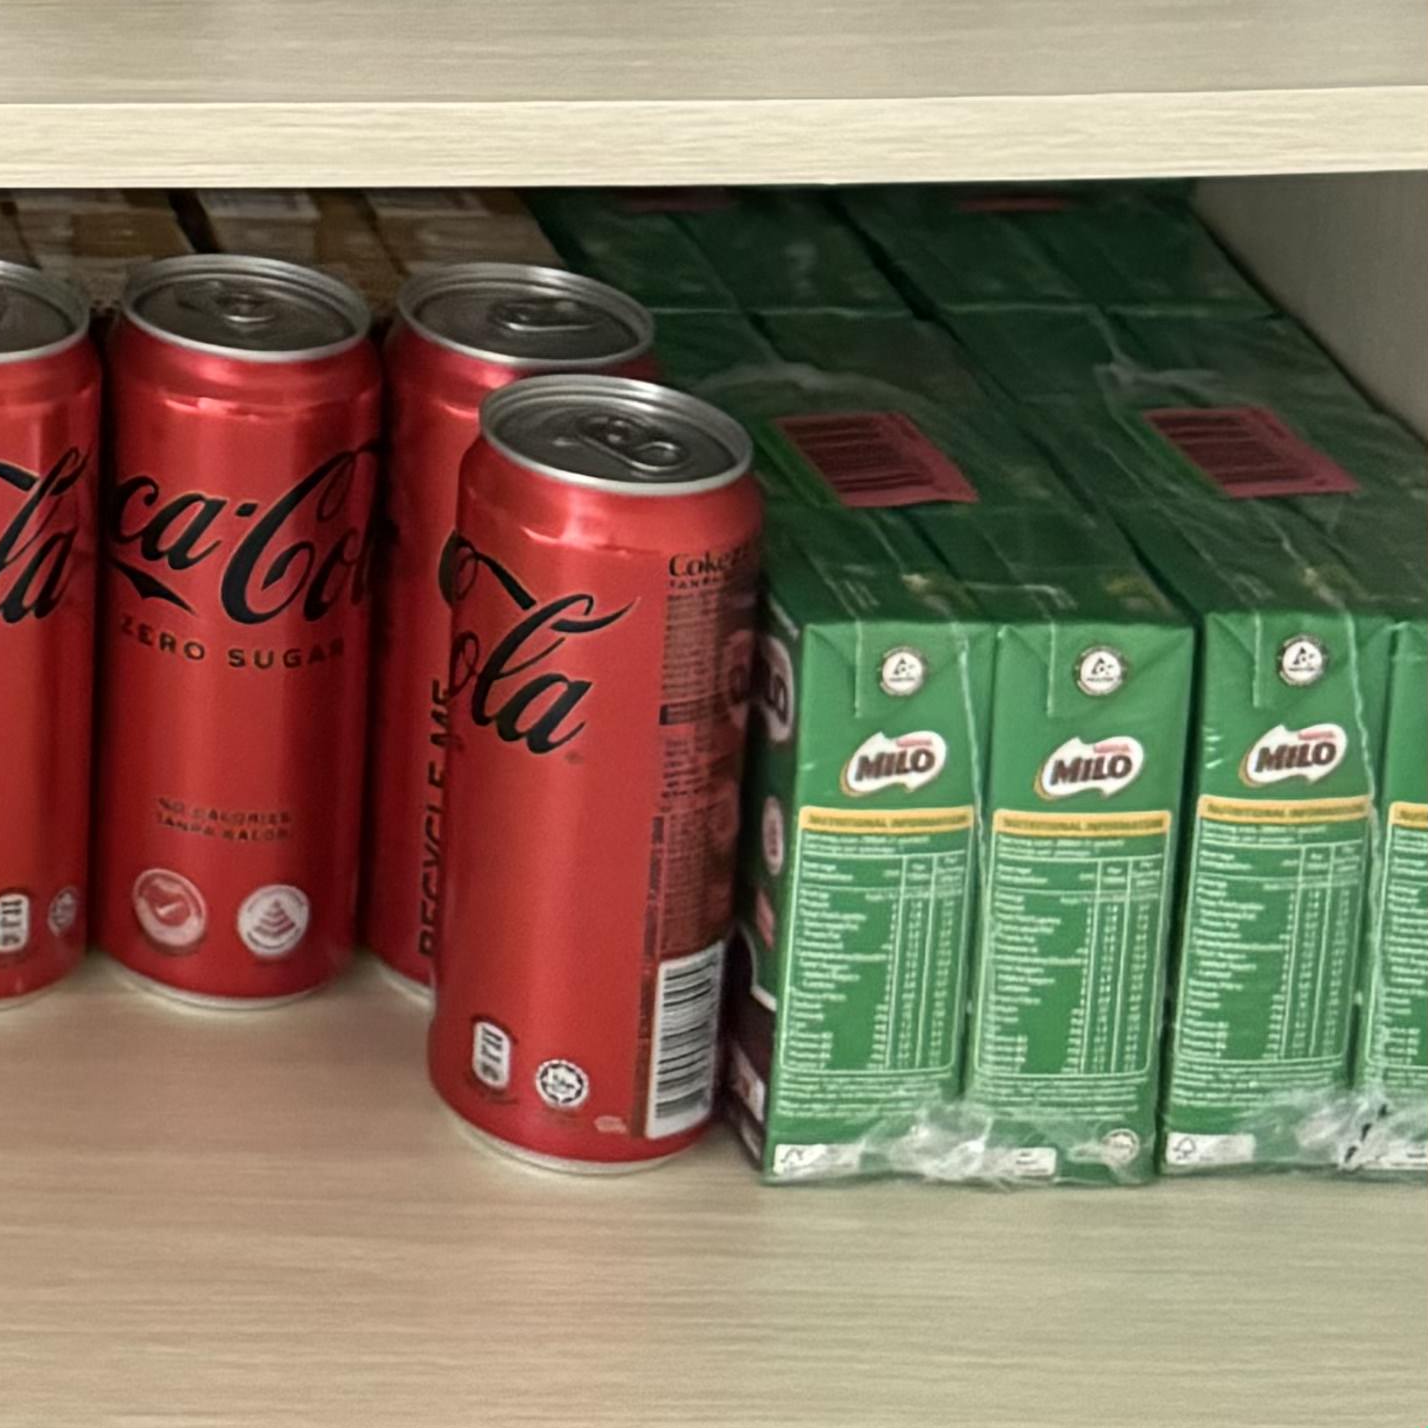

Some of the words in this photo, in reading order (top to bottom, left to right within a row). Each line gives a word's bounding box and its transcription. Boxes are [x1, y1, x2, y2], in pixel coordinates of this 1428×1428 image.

[667, 550, 730, 578] Coke
[121, 614, 206, 661] ZERO
[854, 745, 936, 783] MILO
[1050, 753, 1134, 789] MILO
[1254, 738, 1338, 773] MILO
